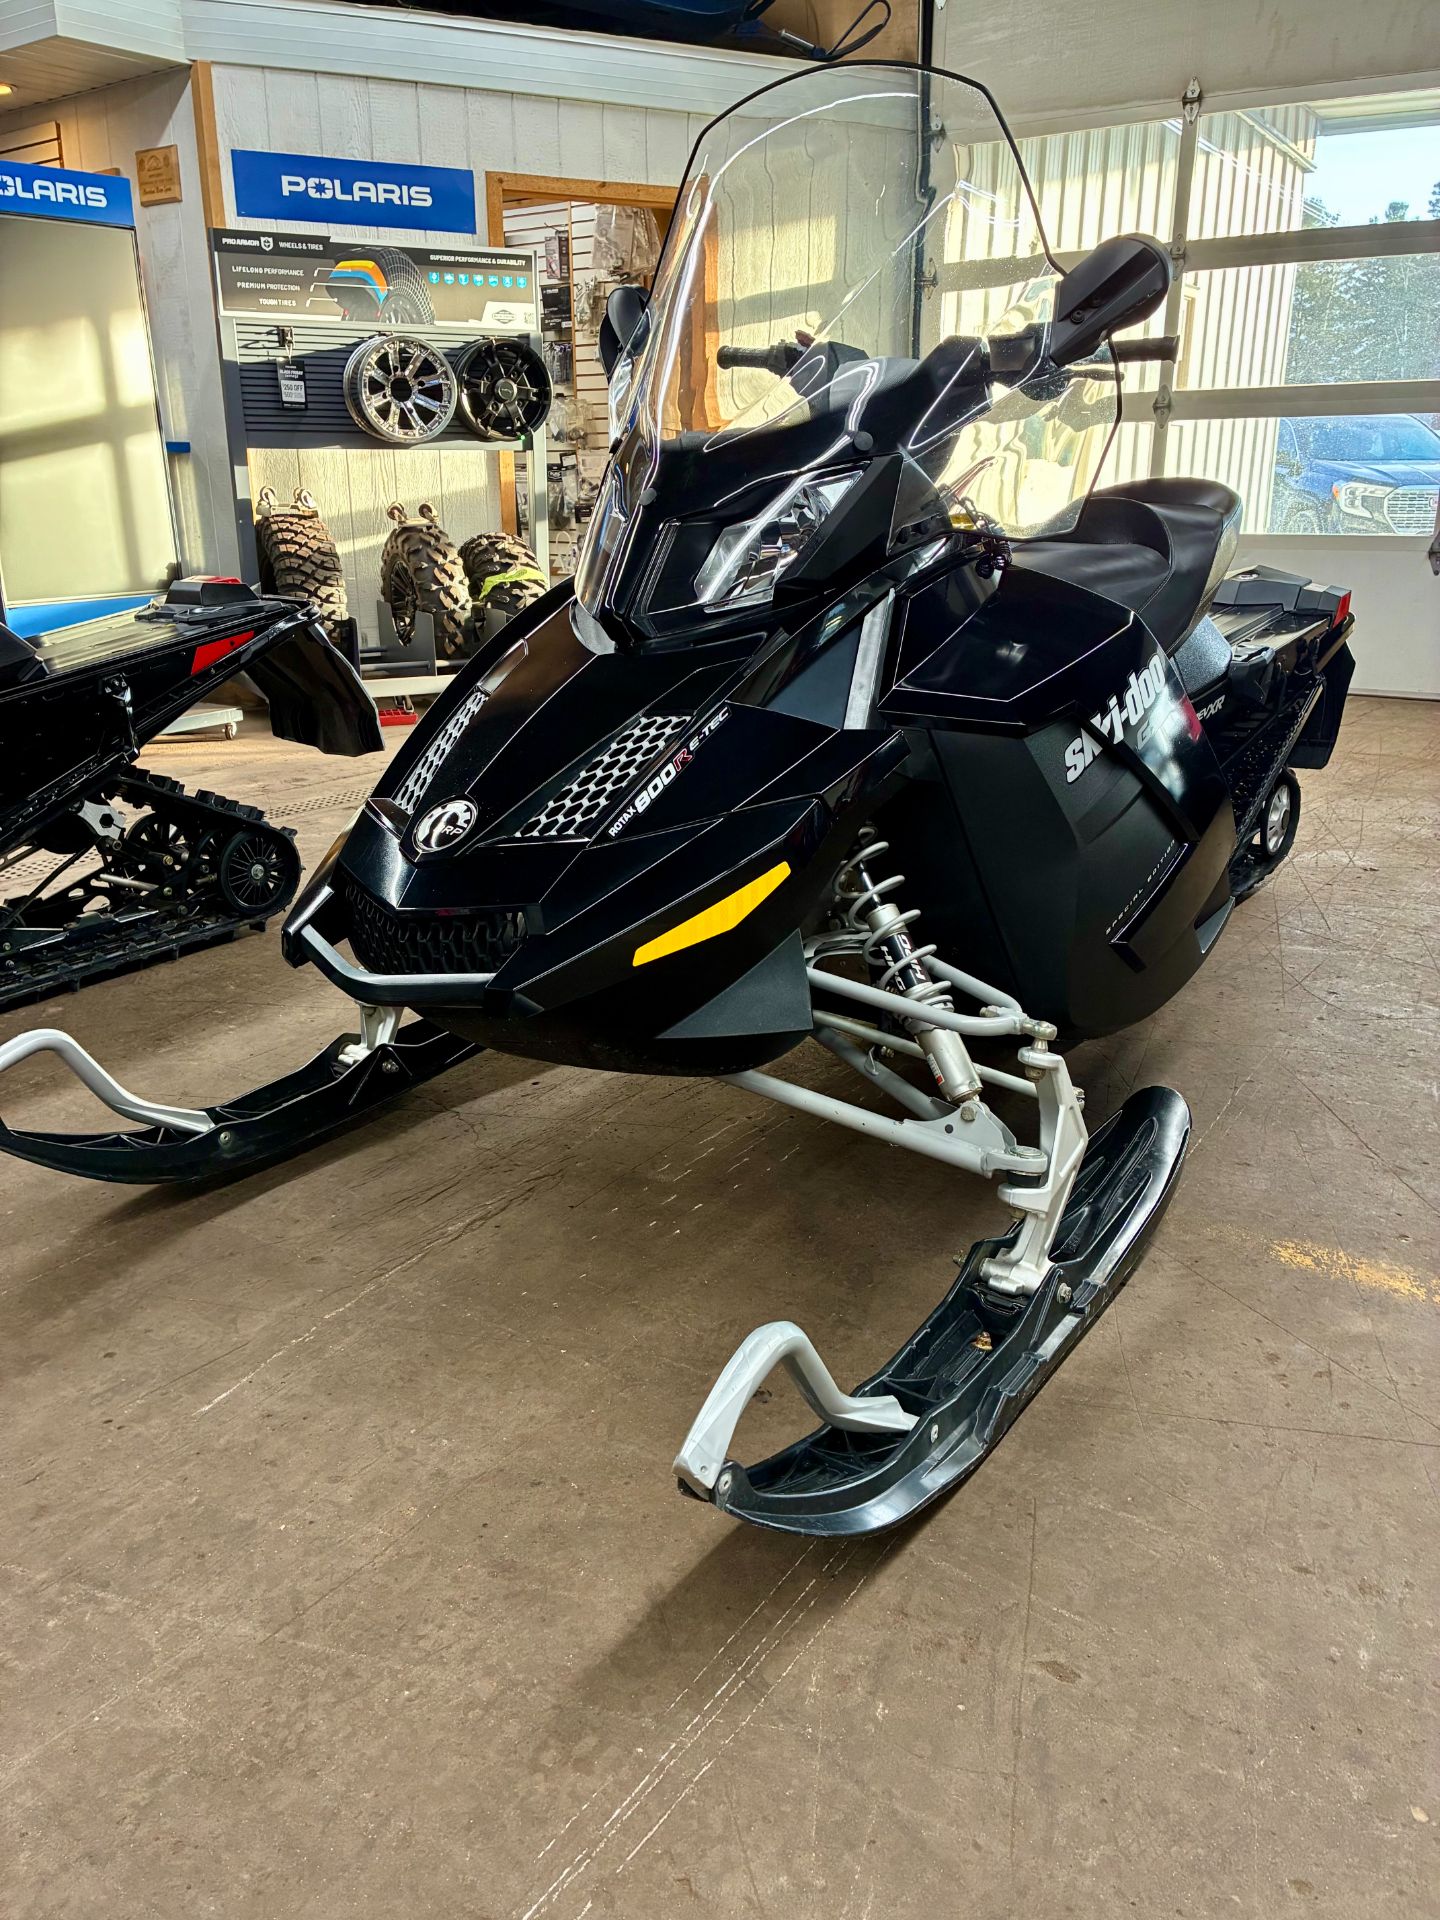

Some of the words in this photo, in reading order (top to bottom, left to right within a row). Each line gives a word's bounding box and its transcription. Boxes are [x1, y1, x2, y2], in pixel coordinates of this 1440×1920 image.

[281, 175, 433, 207] POLARIS
[279, 241, 303, 249] WHEELS
[430, 254, 455, 262] SUPERIOR
[455, 256, 491, 264] PERFORMANCE
[497, 258, 526, 266] DURABILITY
[231, 265, 263, 274] LIFELONG
[264, 267, 304, 276] PERFORMANCE
[236, 281, 266, 290] PREMIUM
[266, 283, 301, 291] PROTECTION
[608, 806, 637, 837] ROTAX
[689, 706, 729, 751] E-TEC
[1105, 888, 1144, 935] SPECIAL
[1147, 839, 1175, 883] EDITION
